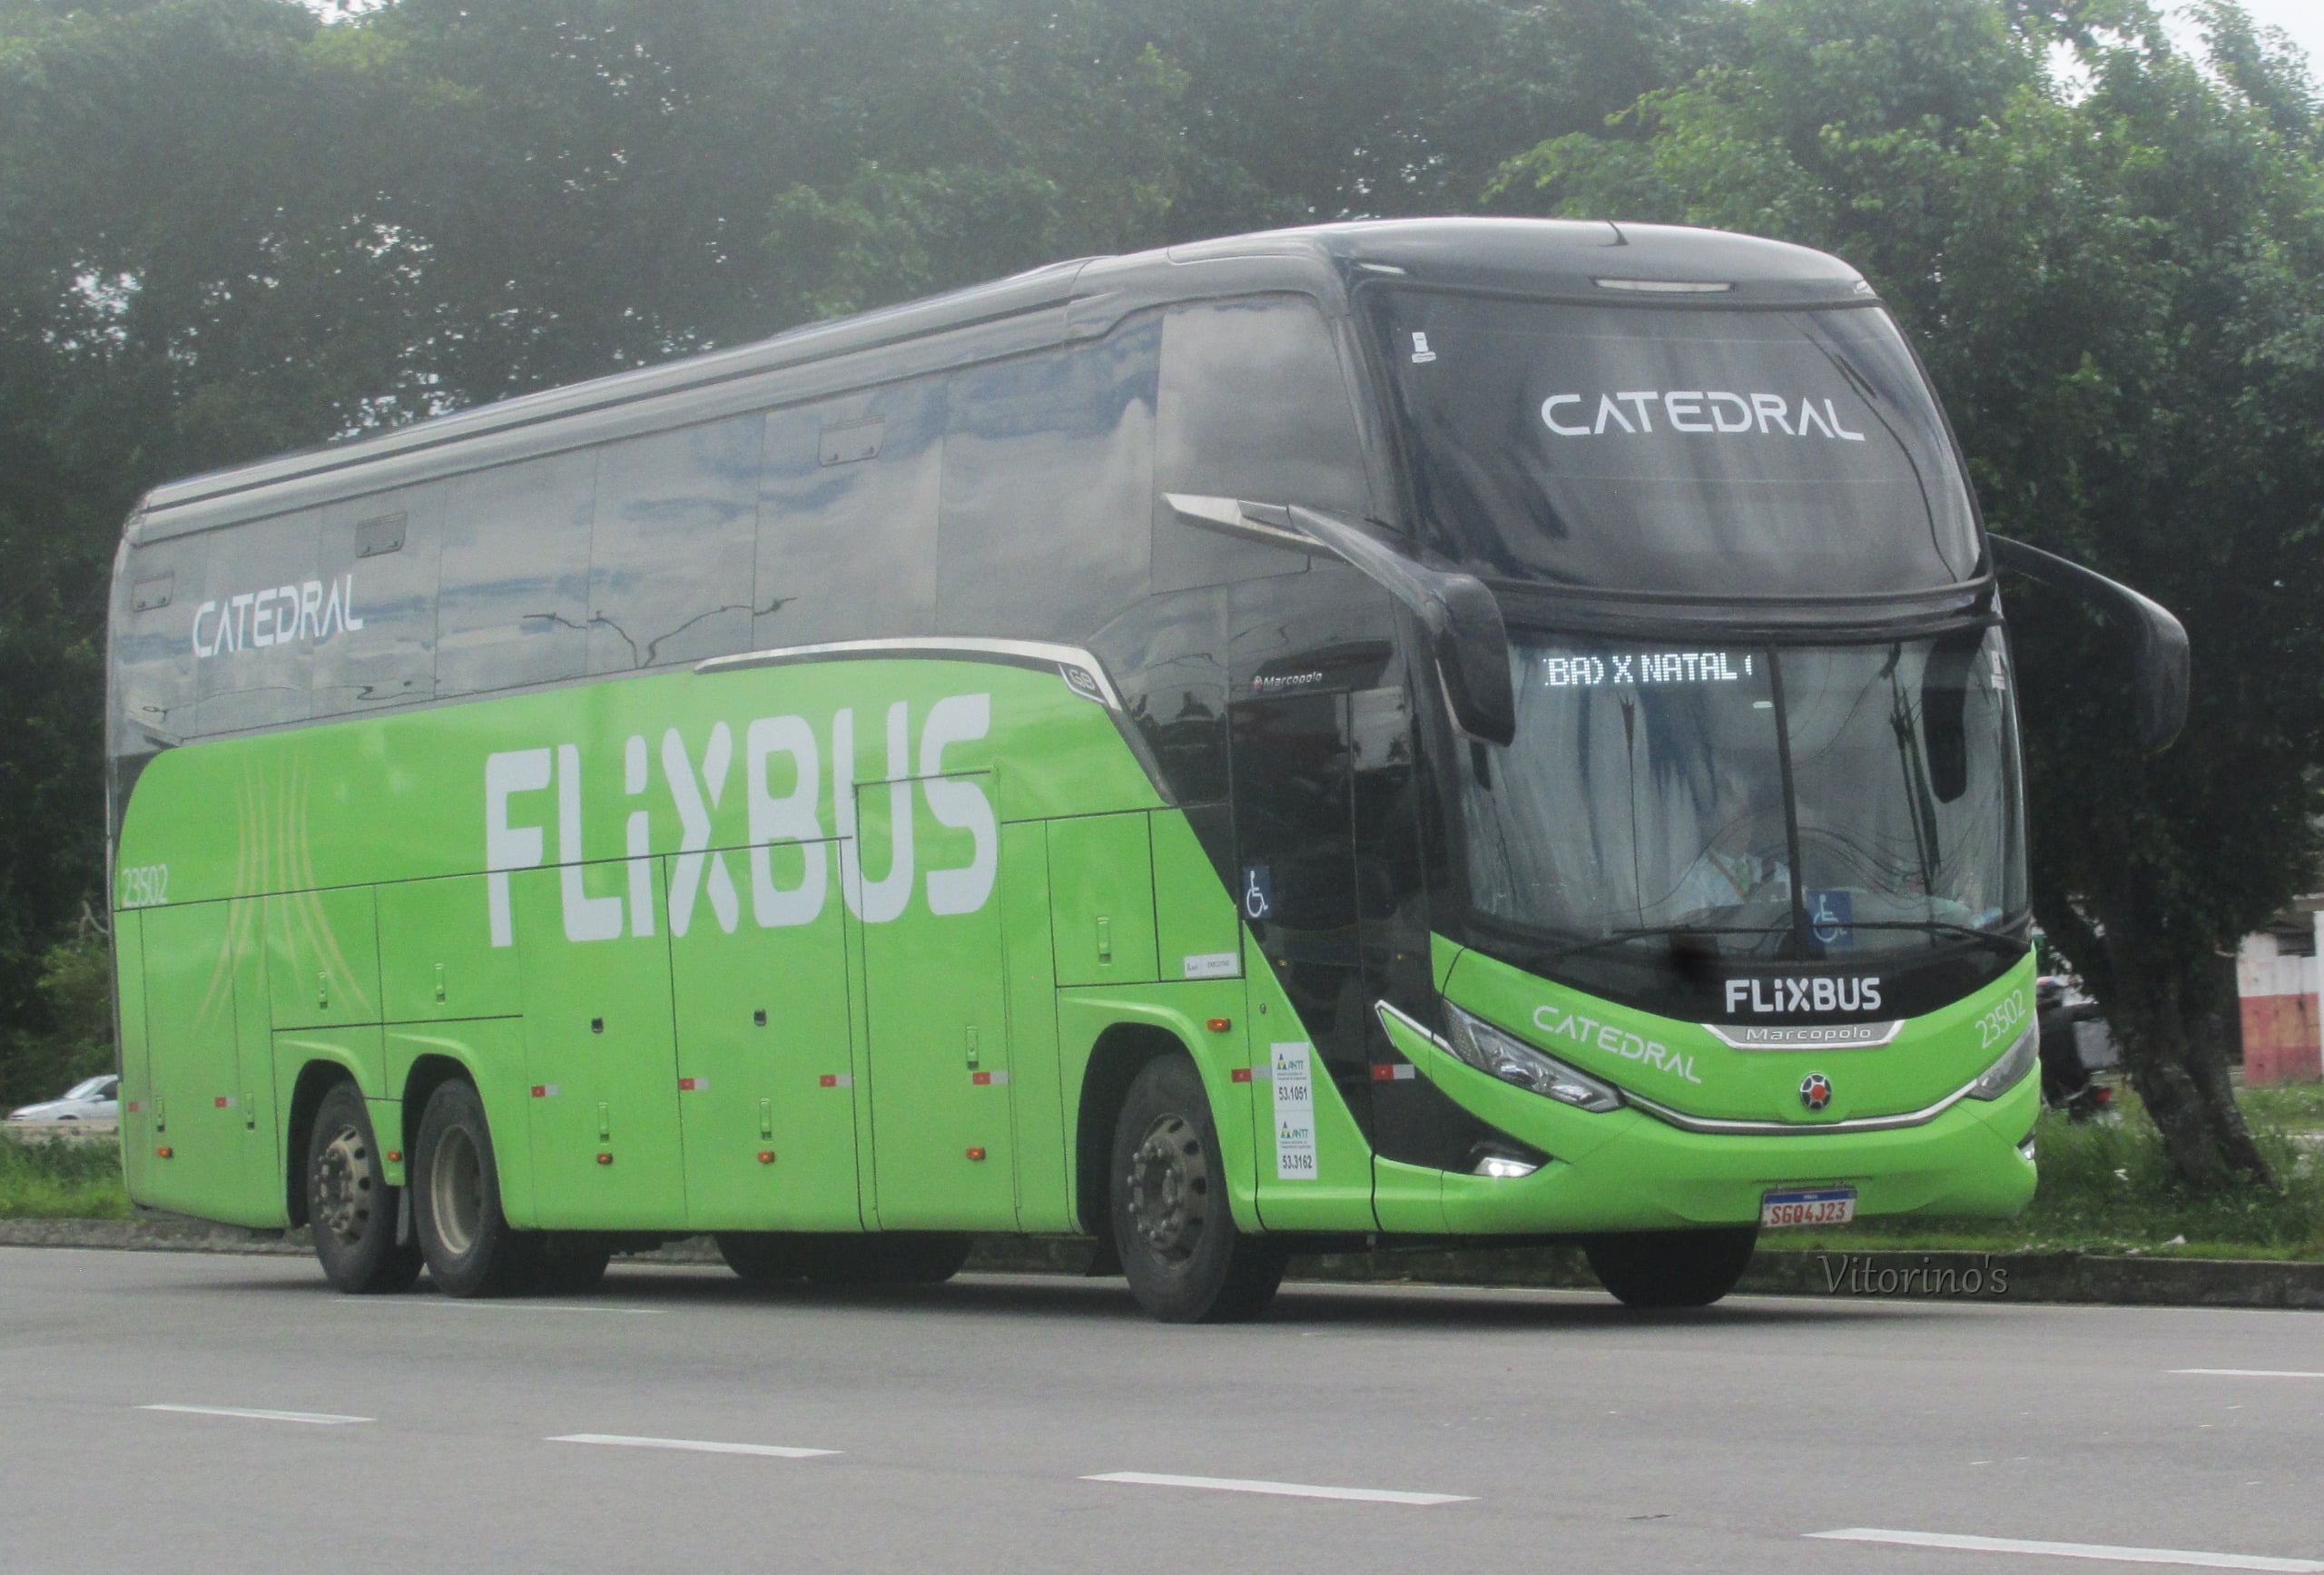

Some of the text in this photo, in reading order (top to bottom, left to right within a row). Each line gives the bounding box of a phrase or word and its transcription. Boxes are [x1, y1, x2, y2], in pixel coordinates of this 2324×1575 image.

[1541, 391, 1866, 441] CATEDRAL
[192, 574, 363, 658] CATEDRAL
[1612, 655, 1633, 683] X
[1641, 652, 1738, 682] NATAL
[122, 863, 169, 909] 23502
[1746, 1026, 1872, 1041] Marcopolo
[1974, 989, 2025, 1049] 23502
[1532, 1005, 1702, 1085] CATEDRAL
[1278, 1086, 1308, 1101] 53.1051
[1282, 1154, 1313, 1169] 53.3162
